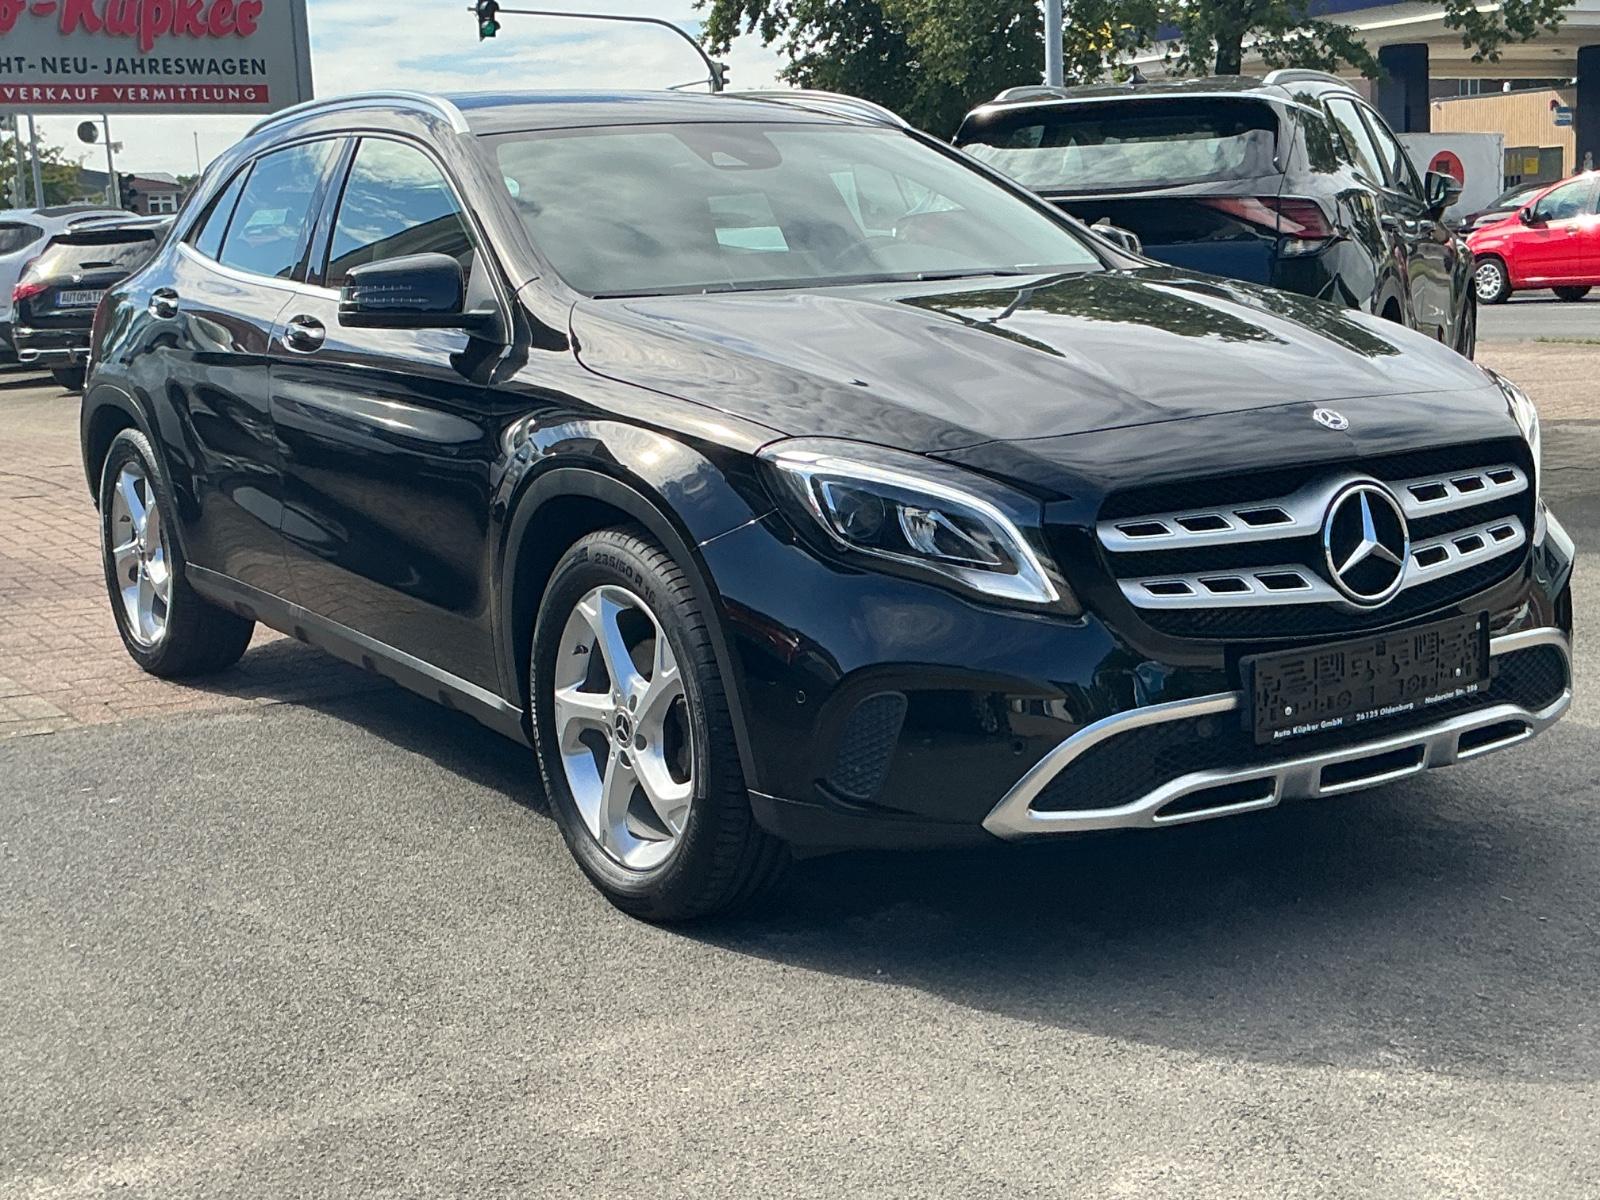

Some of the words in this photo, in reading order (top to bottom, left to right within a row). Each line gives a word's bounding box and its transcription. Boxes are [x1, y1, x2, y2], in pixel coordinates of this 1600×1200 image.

[3, 87, 100, 100] VERKAUF
[113, 87, 257, 100] VERMITTLUNG
[62, 291, 103, 302] AUTOMATI
[1273, 730, 1291, 739] Auto
[1320, 717, 1343, 729] GmbH
[1380, 702, 1414, 716] Oldenburg
